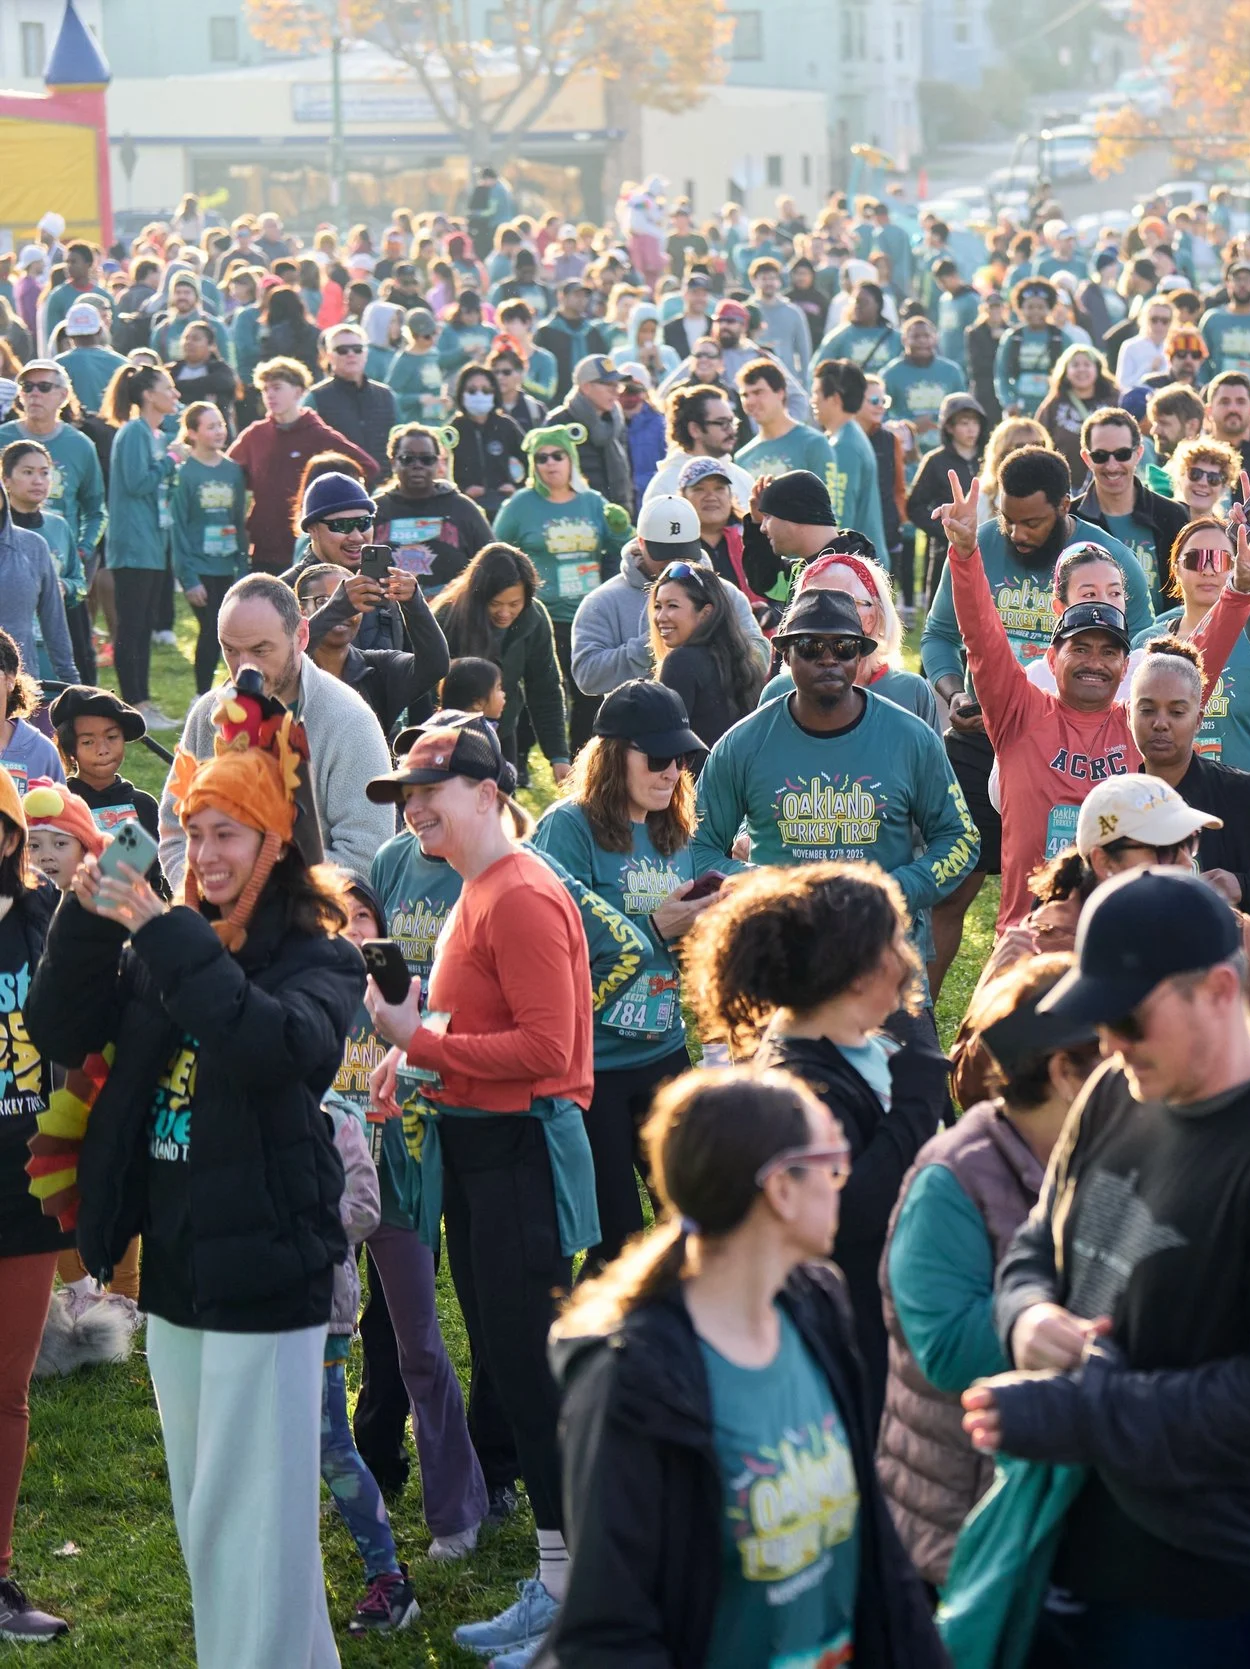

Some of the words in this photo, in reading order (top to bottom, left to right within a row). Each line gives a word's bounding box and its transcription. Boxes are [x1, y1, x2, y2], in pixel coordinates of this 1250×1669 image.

[998, 579, 1056, 613] OAKLAN
[998, 610, 1037, 631] URKEY
[1007, 628, 1030, 637] OVEMBER
[1203, 697, 1230, 717] ROT
[1200, 721, 1215, 730] 2025
[1050, 747, 1128, 781] ACRC
[783, 777, 875, 821] OAKLAND
[777, 820, 838, 845] TURKEY
[839, 820, 881, 845] TROT
[792, 848, 827, 859] NOVEMBER
[846, 848, 864, 859] 2025
[581, 890, 644, 951] FEAST
[343, 1035, 386, 1068] LAND
